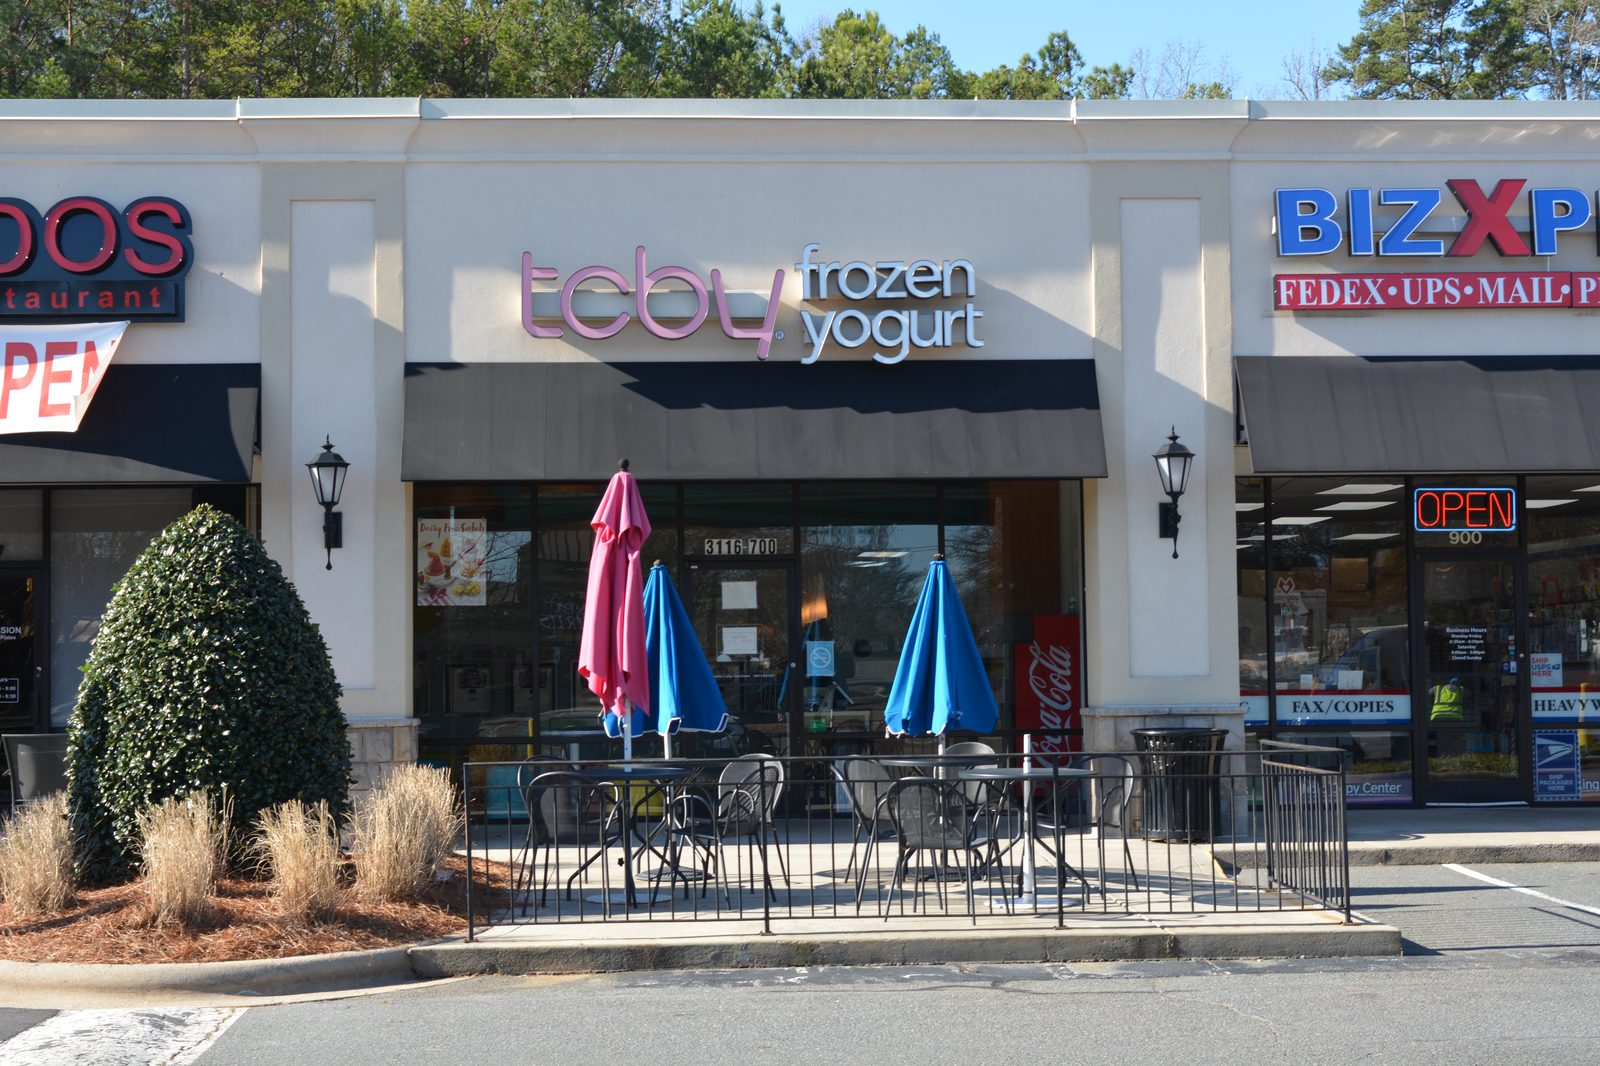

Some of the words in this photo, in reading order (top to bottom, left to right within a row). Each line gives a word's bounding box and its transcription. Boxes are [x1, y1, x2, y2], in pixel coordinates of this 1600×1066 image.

[1274, 178, 1600, 257] BIZXP
[795, 242, 977, 302] frozen
[5, 286, 162, 309] taurant
[799, 302, 986, 365] yogurt
[0, 340, 117, 420] PEN
[1416, 491, 1513, 528] OPEN
[706, 539, 777, 555] 3116-700
[1449, 531, 1482, 545] 900
[0, 626, 21, 634] SION
[1292, 699, 1394, 715] FAX/COPIES
[1362, 782, 1401, 794] Center
